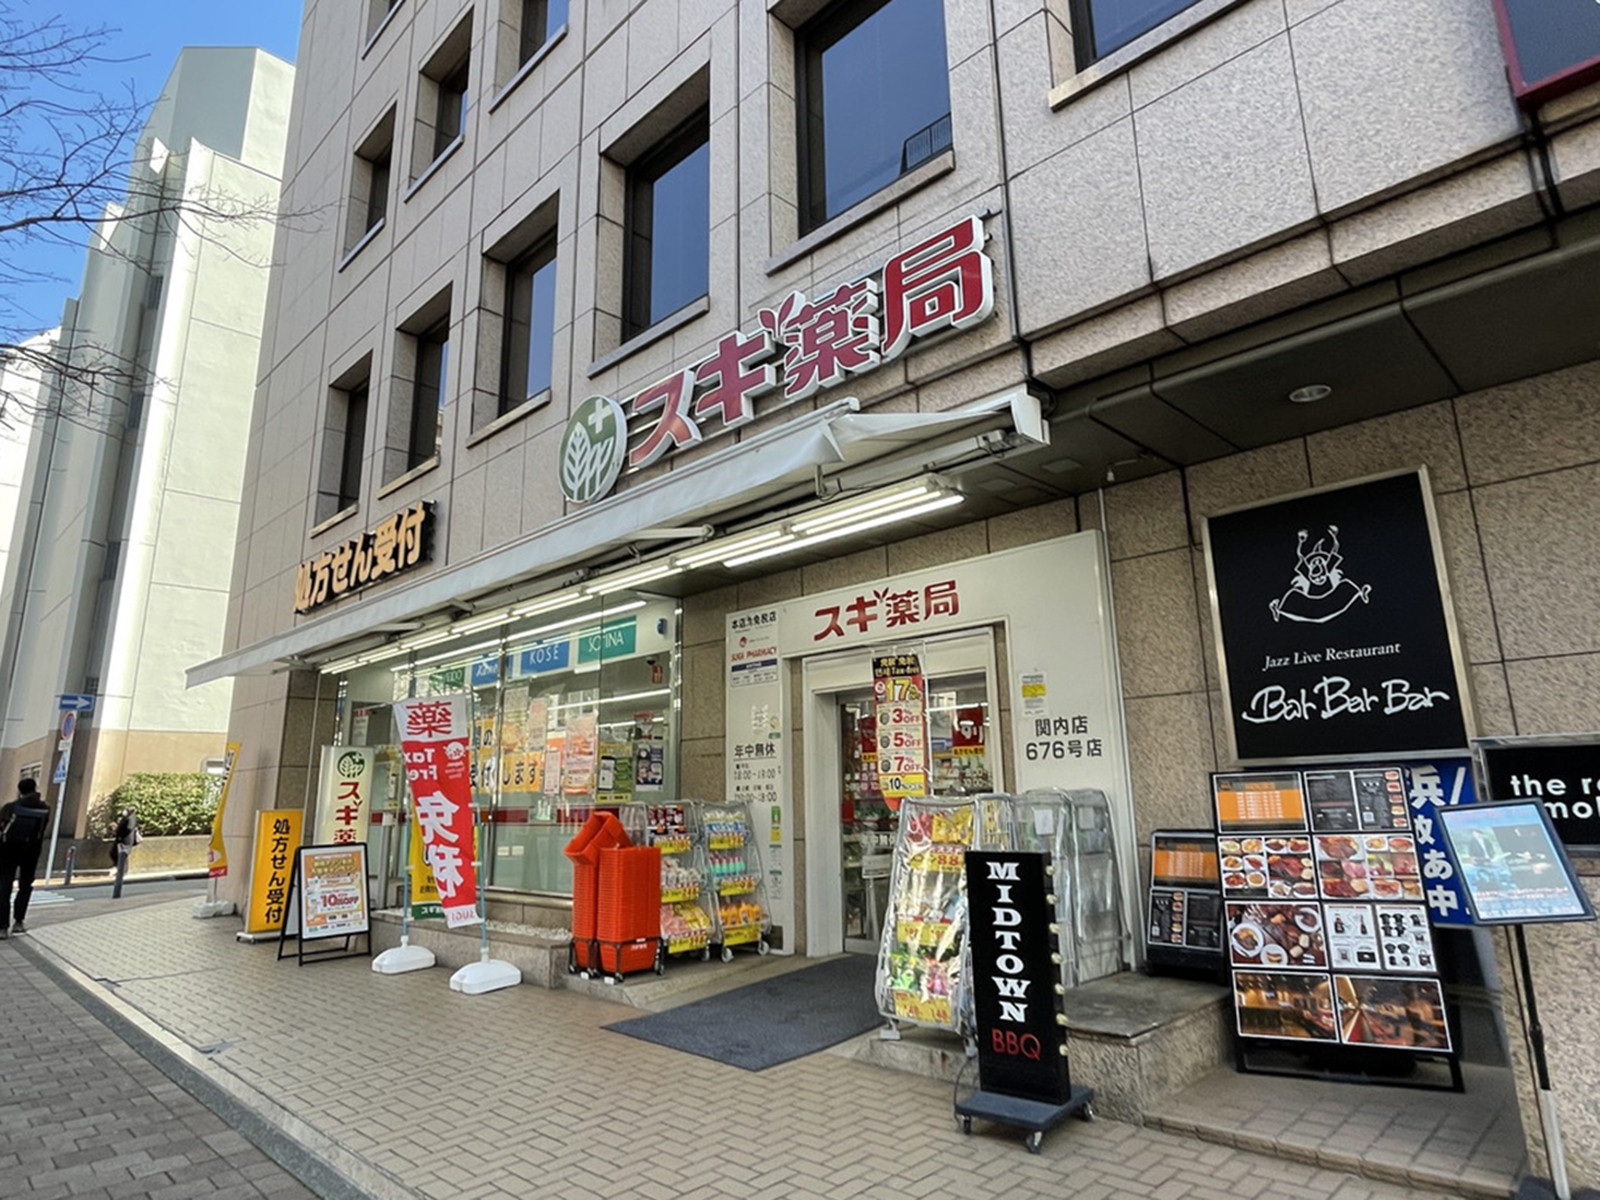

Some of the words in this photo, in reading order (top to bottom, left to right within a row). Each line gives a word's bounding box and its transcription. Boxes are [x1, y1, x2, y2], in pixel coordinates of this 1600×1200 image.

[630, 214, 990, 468] スギ薬局
[814, 580, 960, 641] スギ薬局
[1262, 654, 1290, 671] Jazz
[1293, 650, 1322, 666] Live
[1325, 643, 1402, 662] Restaurant
[1035, 715, 1088, 737] 関内店
[1026, 739, 1102, 760] 676号店
[1510, 774, 1567, 796] the
[1581, 777, 1600, 795] r
[265, 819, 291, 925] 処方せん受付
[986, 861, 1031, 1023] MIDTOWN
[991, 1028, 1041, 1061] BBQ
